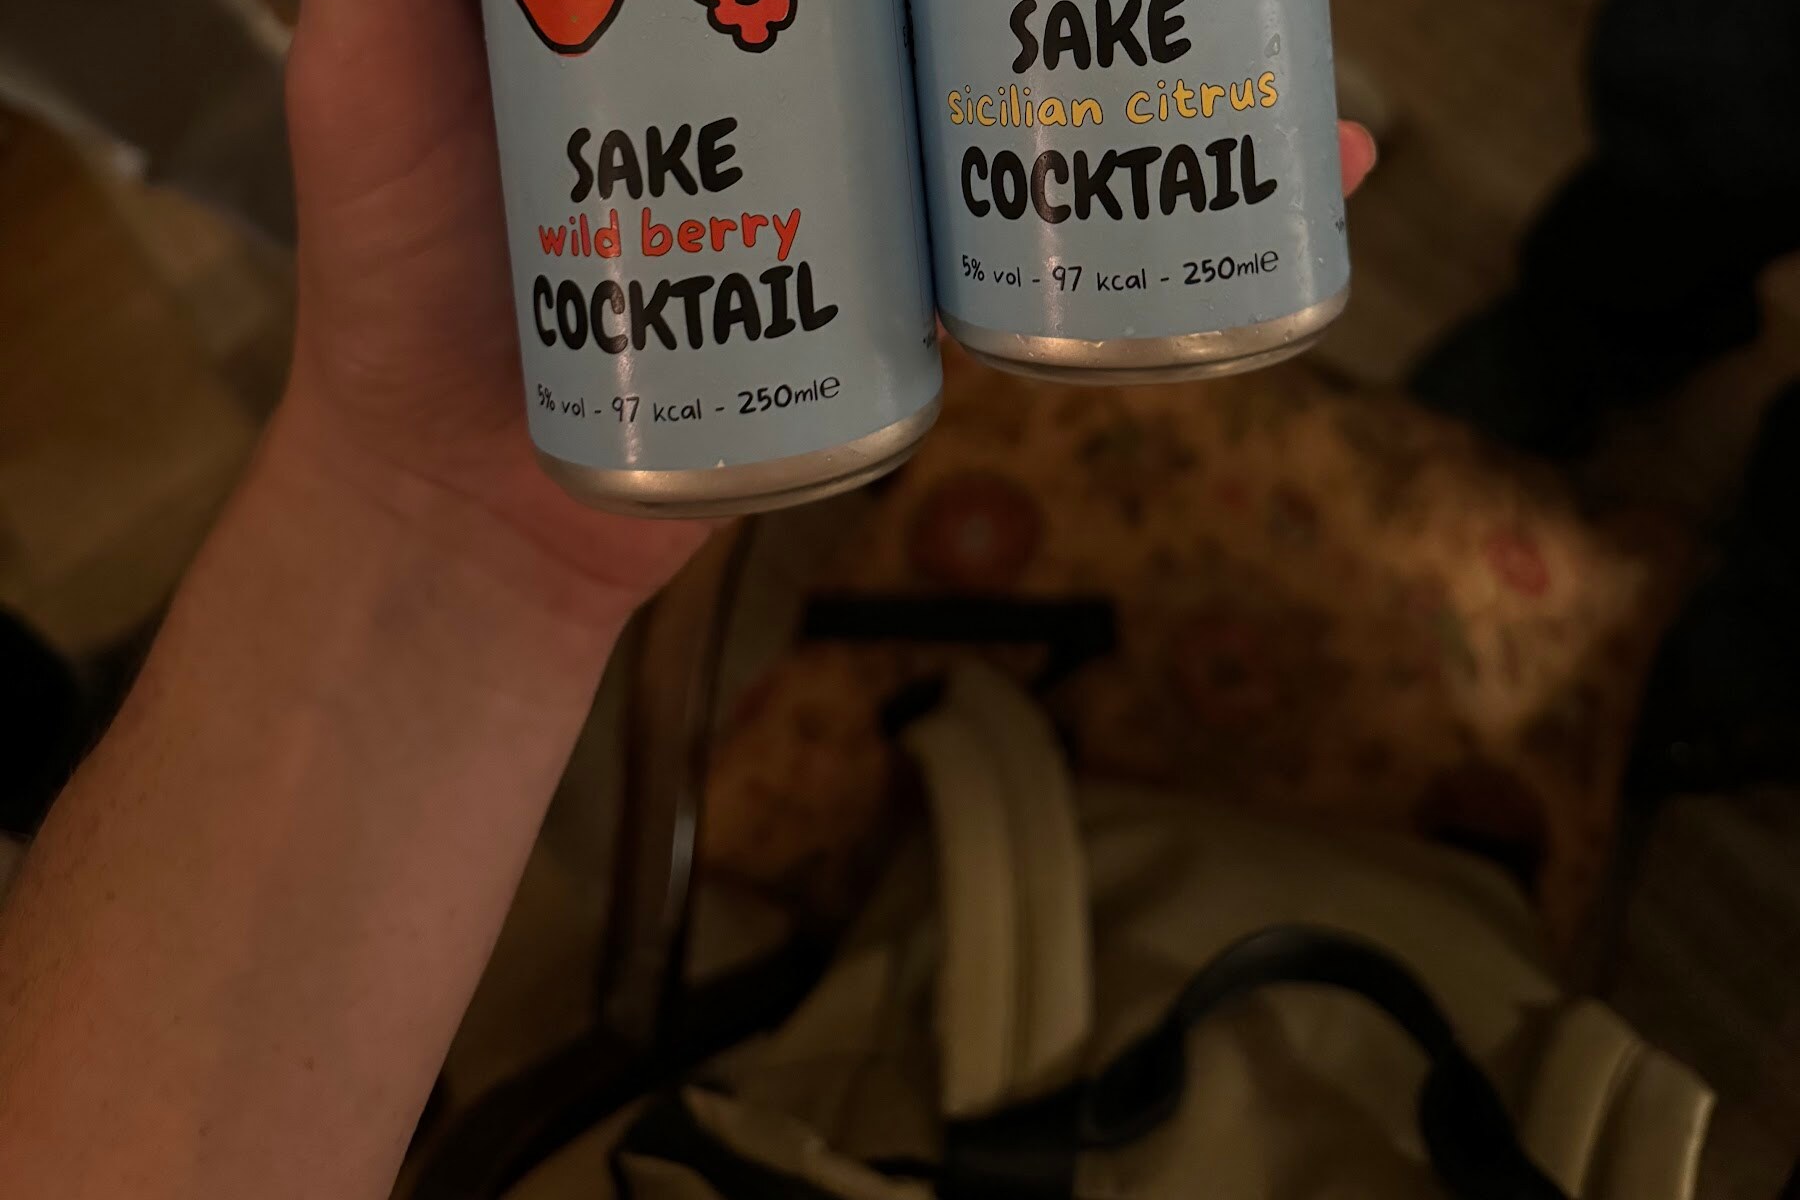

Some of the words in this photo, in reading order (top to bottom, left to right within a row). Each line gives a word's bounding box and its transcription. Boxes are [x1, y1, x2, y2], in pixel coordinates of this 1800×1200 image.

[947, 83, 1104, 128] sicilian
[1125, 71, 1279, 125] citrus
[567, 117, 743, 203] SAKE
[961, 135, 1278, 224] COCKTAIL
[538, 208, 622, 259] wild
[641, 206, 801, 261] berry
[962, 254, 985, 281] 5%
[993, 266, 1021, 287] vol
[1052, 265, 1082, 291] 97
[1096, 268, 1147, 291] kcal
[532, 261, 839, 354] COCKTAIL
[537, 383, 555, 411] 5%
[562, 397, 585, 418] vol
[611, 396, 640, 423] 97
[653, 398, 702, 422] kcal
